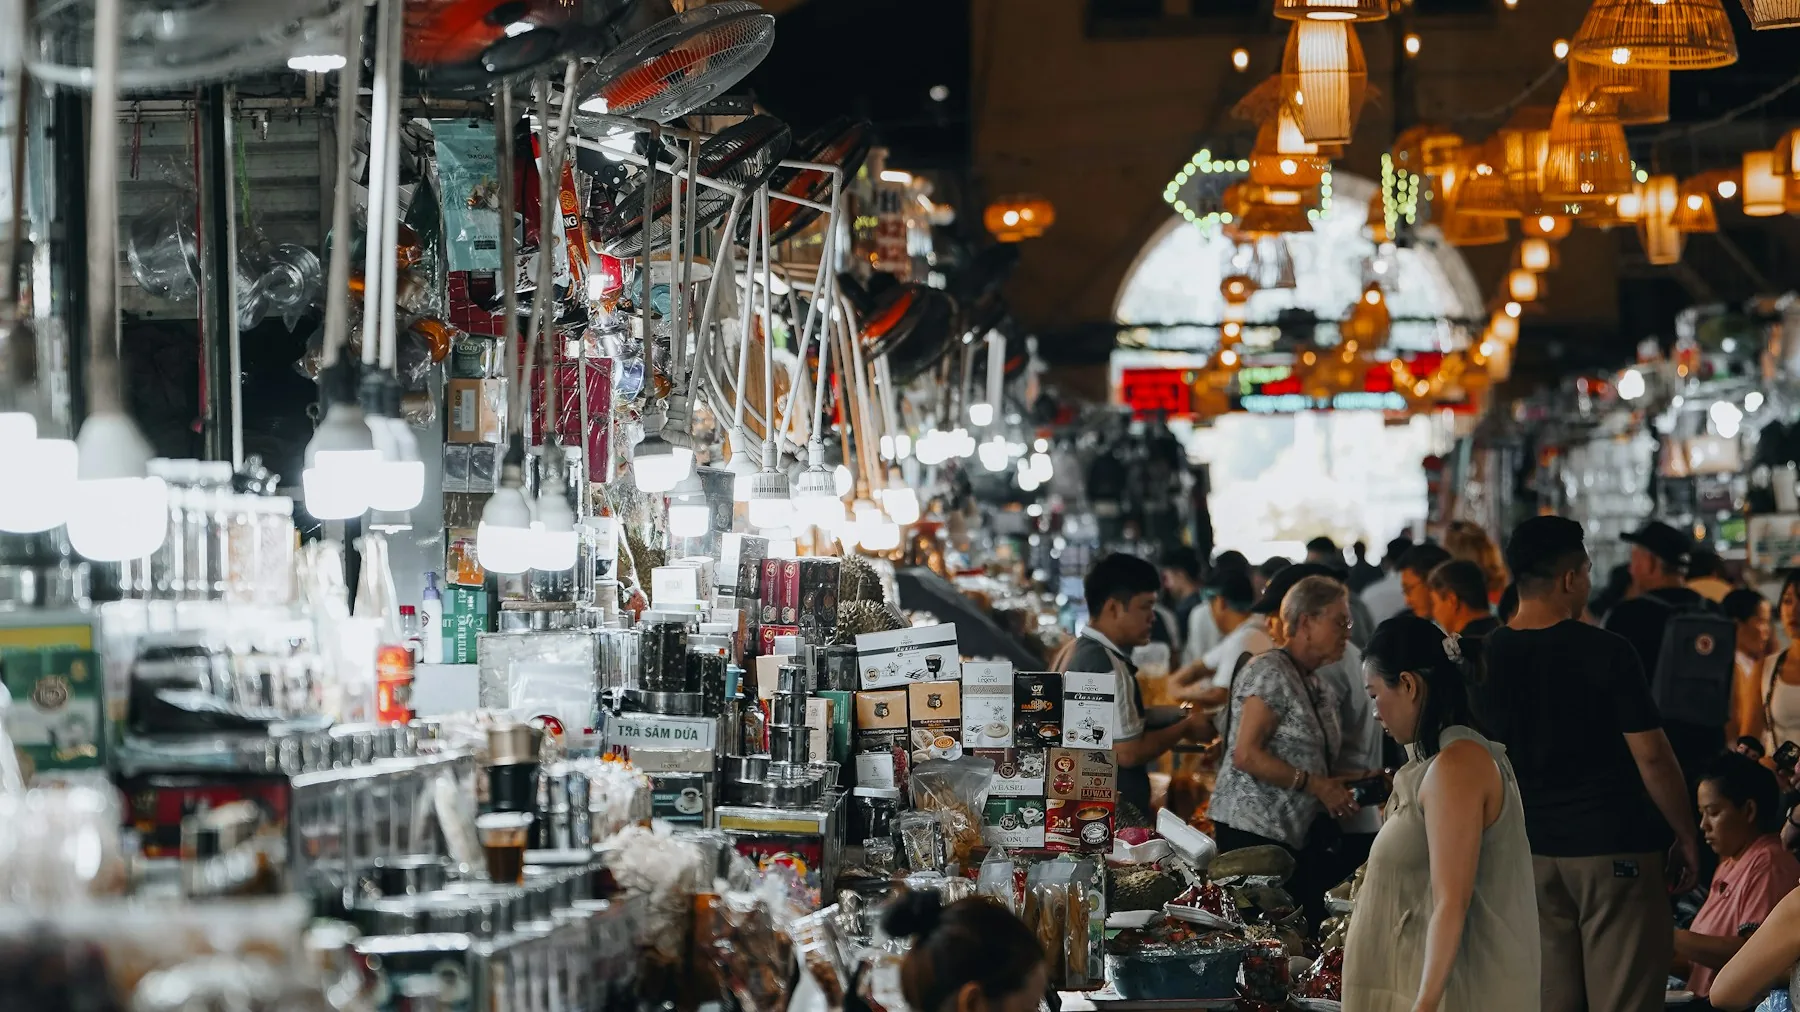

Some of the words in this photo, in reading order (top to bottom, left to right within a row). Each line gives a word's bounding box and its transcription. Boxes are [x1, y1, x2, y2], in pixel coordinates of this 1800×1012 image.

[459, 343, 478, 353] Cozy
[1074, 693, 1103, 701] Classic
[617, 724, 640, 737] TRÀ
[645, 725, 670, 739] SÂM
[674, 726, 698, 741] DỨA
[1082, 789, 1111, 798] LUWAK
